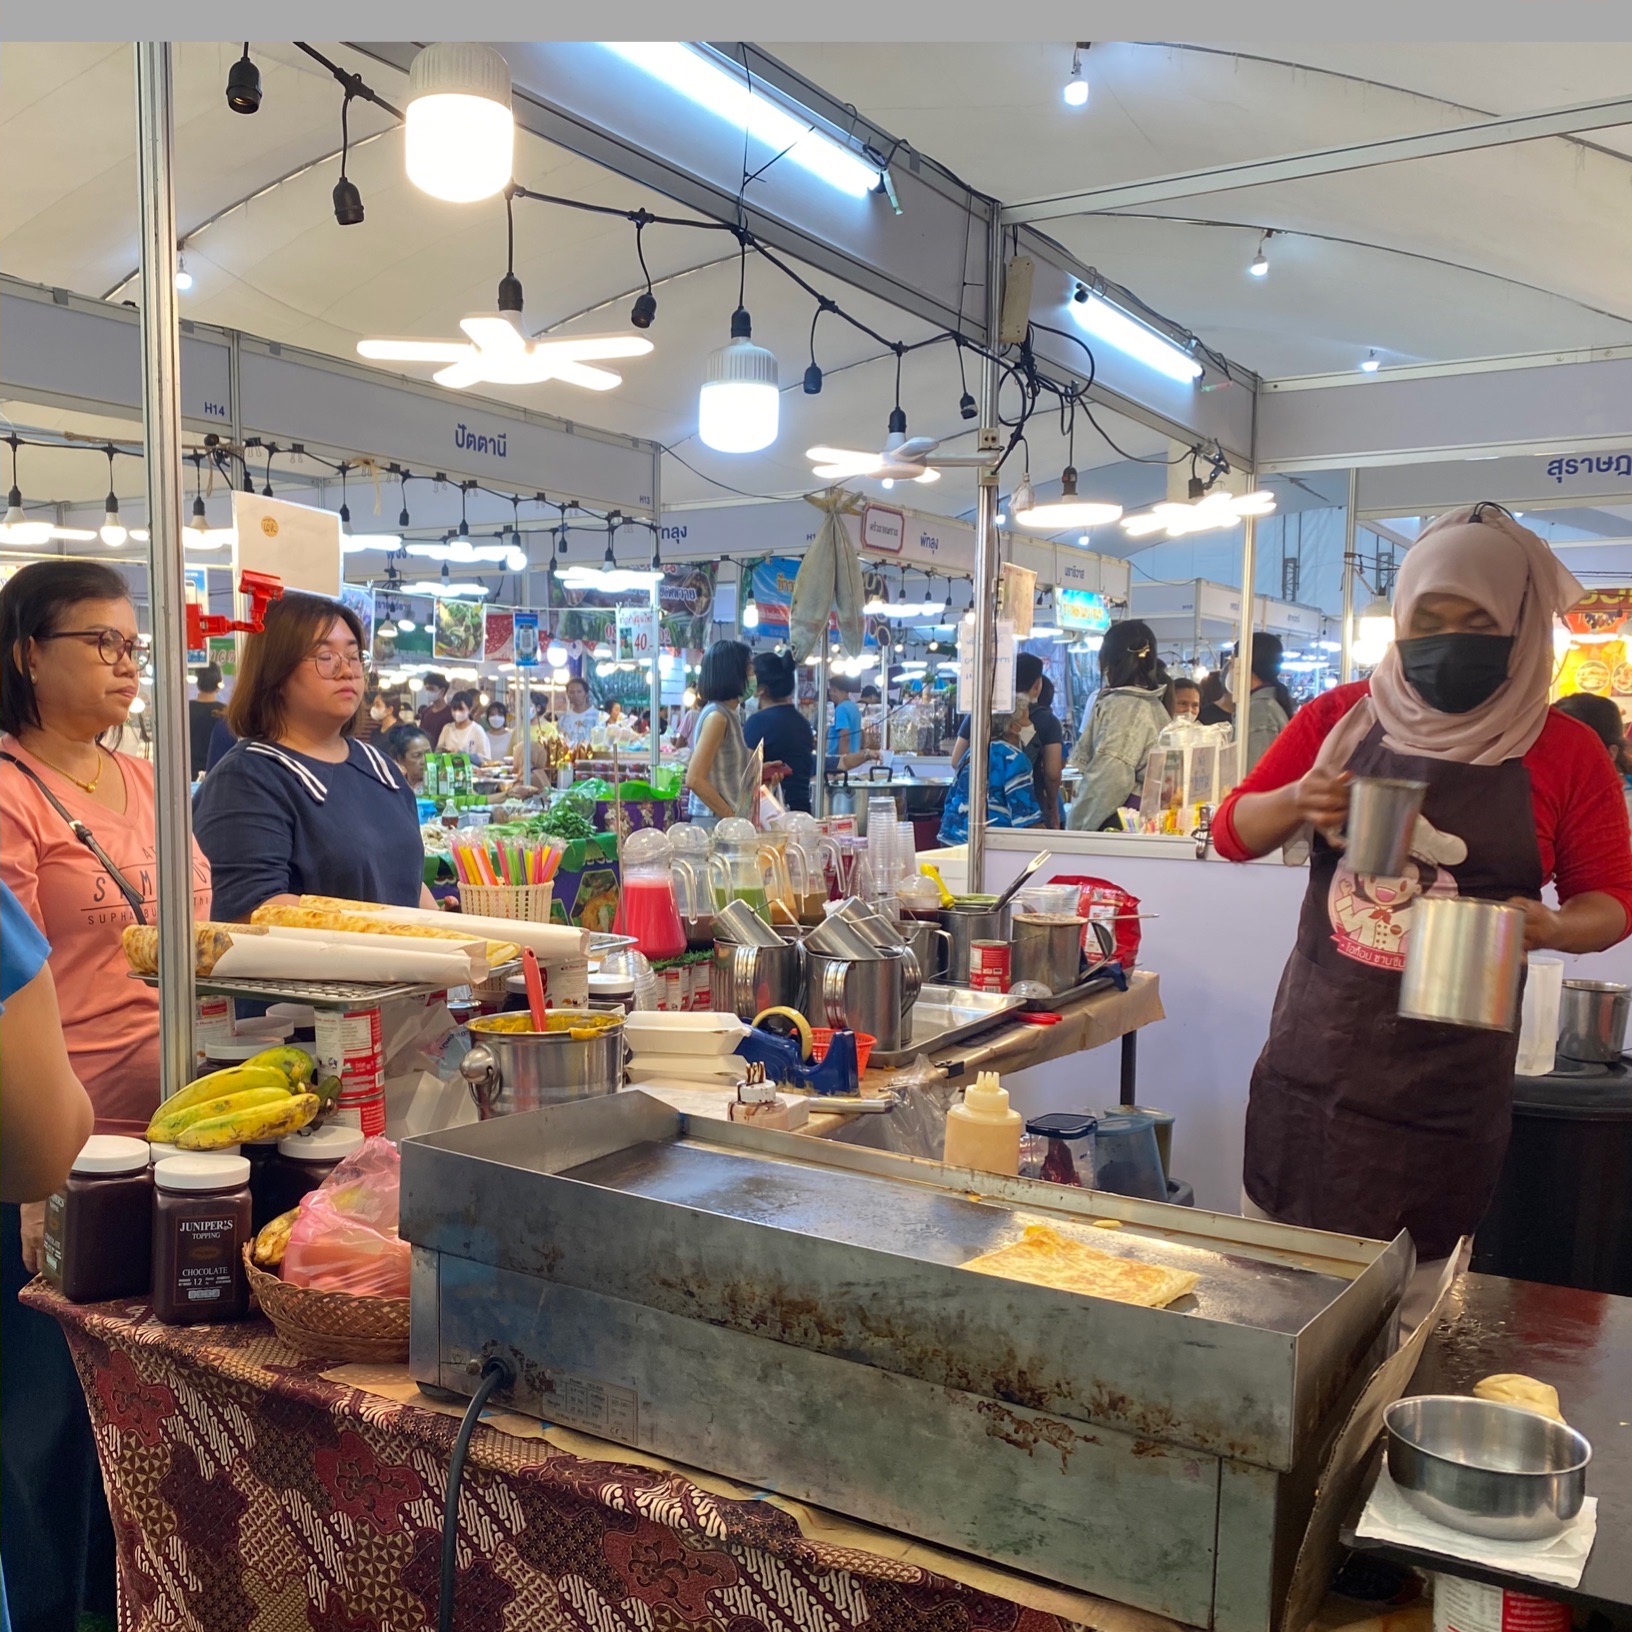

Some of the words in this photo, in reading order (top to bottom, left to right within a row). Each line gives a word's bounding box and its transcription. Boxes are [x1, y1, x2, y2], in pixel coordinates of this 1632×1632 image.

[204, 400, 225, 417] H14
[455, 424, 507, 458] ปัตตานี
[661, 525, 688, 544] ทลุง
[920, 531, 939, 555] พัทลุง
[179, 1219, 234, 1233] JUNIPER'S
[191, 1232, 221, 1240] TOPPING
[182, 1266, 229, 1277] CHOCOLATE
